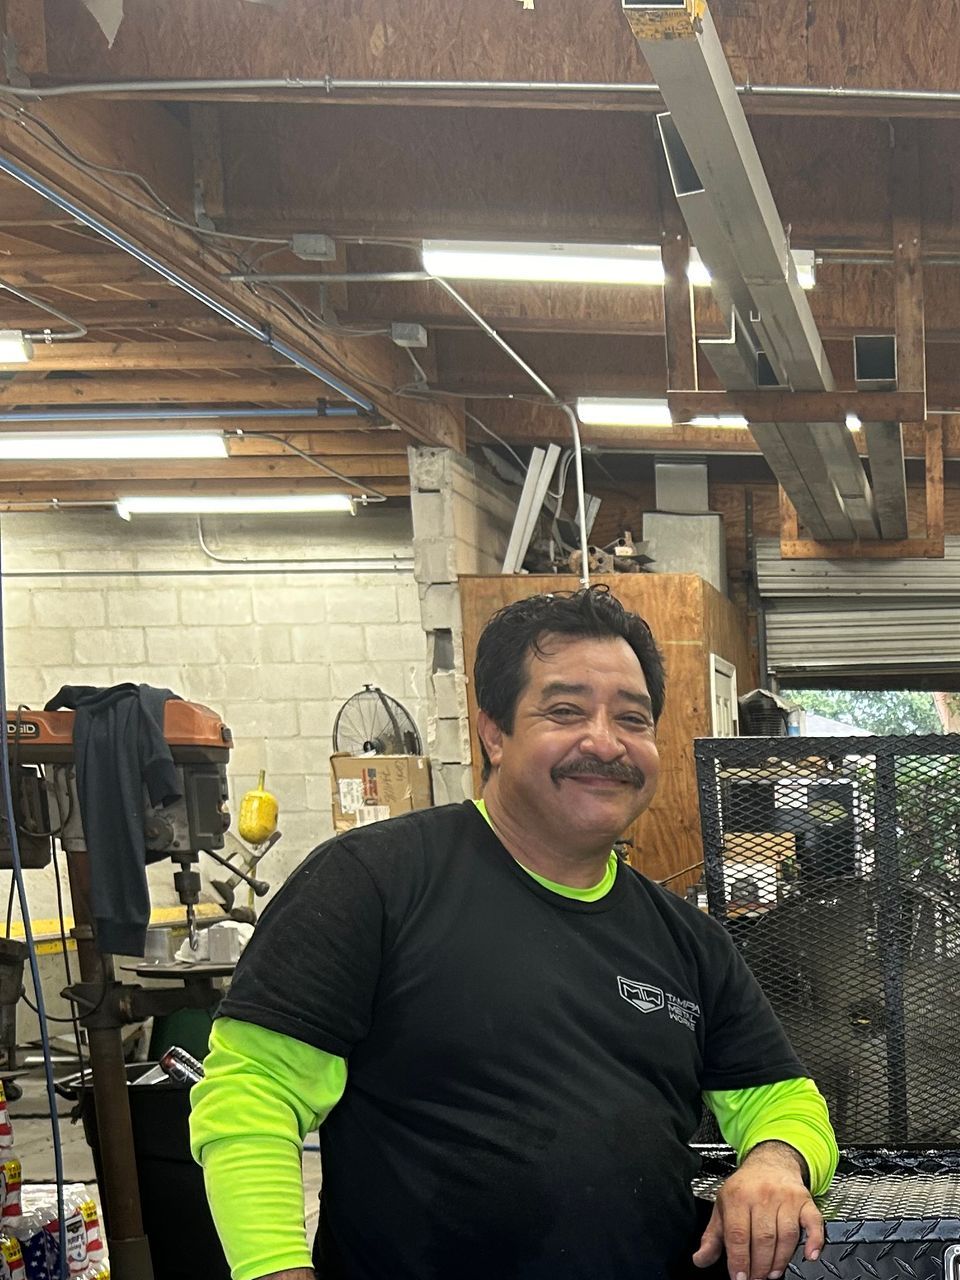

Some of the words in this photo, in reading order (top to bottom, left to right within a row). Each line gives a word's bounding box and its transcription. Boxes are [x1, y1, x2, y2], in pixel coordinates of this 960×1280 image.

[665, 992, 701, 1014] TAMPA
[667, 1003, 697, 1024] METAL
[668, 1011, 696, 1032] WORKS
